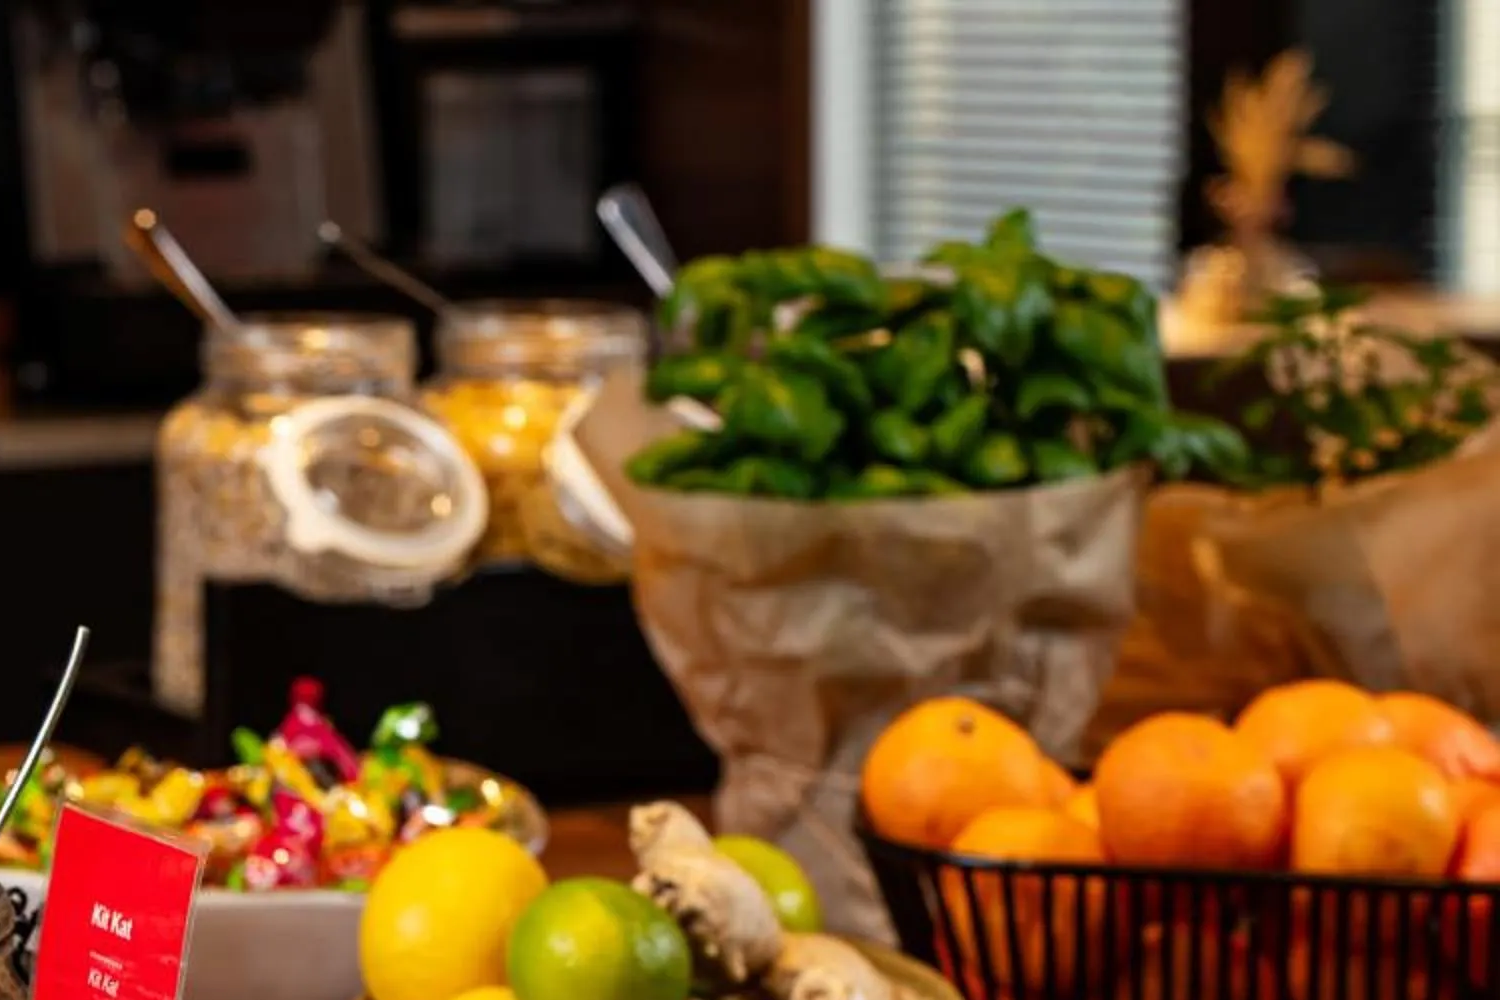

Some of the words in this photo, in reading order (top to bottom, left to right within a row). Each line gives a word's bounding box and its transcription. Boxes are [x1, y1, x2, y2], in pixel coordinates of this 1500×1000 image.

[91, 902, 110, 931] Kit
[110, 910, 133, 940] Kat
[88, 967, 102, 990] Kit
[101, 973, 120, 998] Kat
